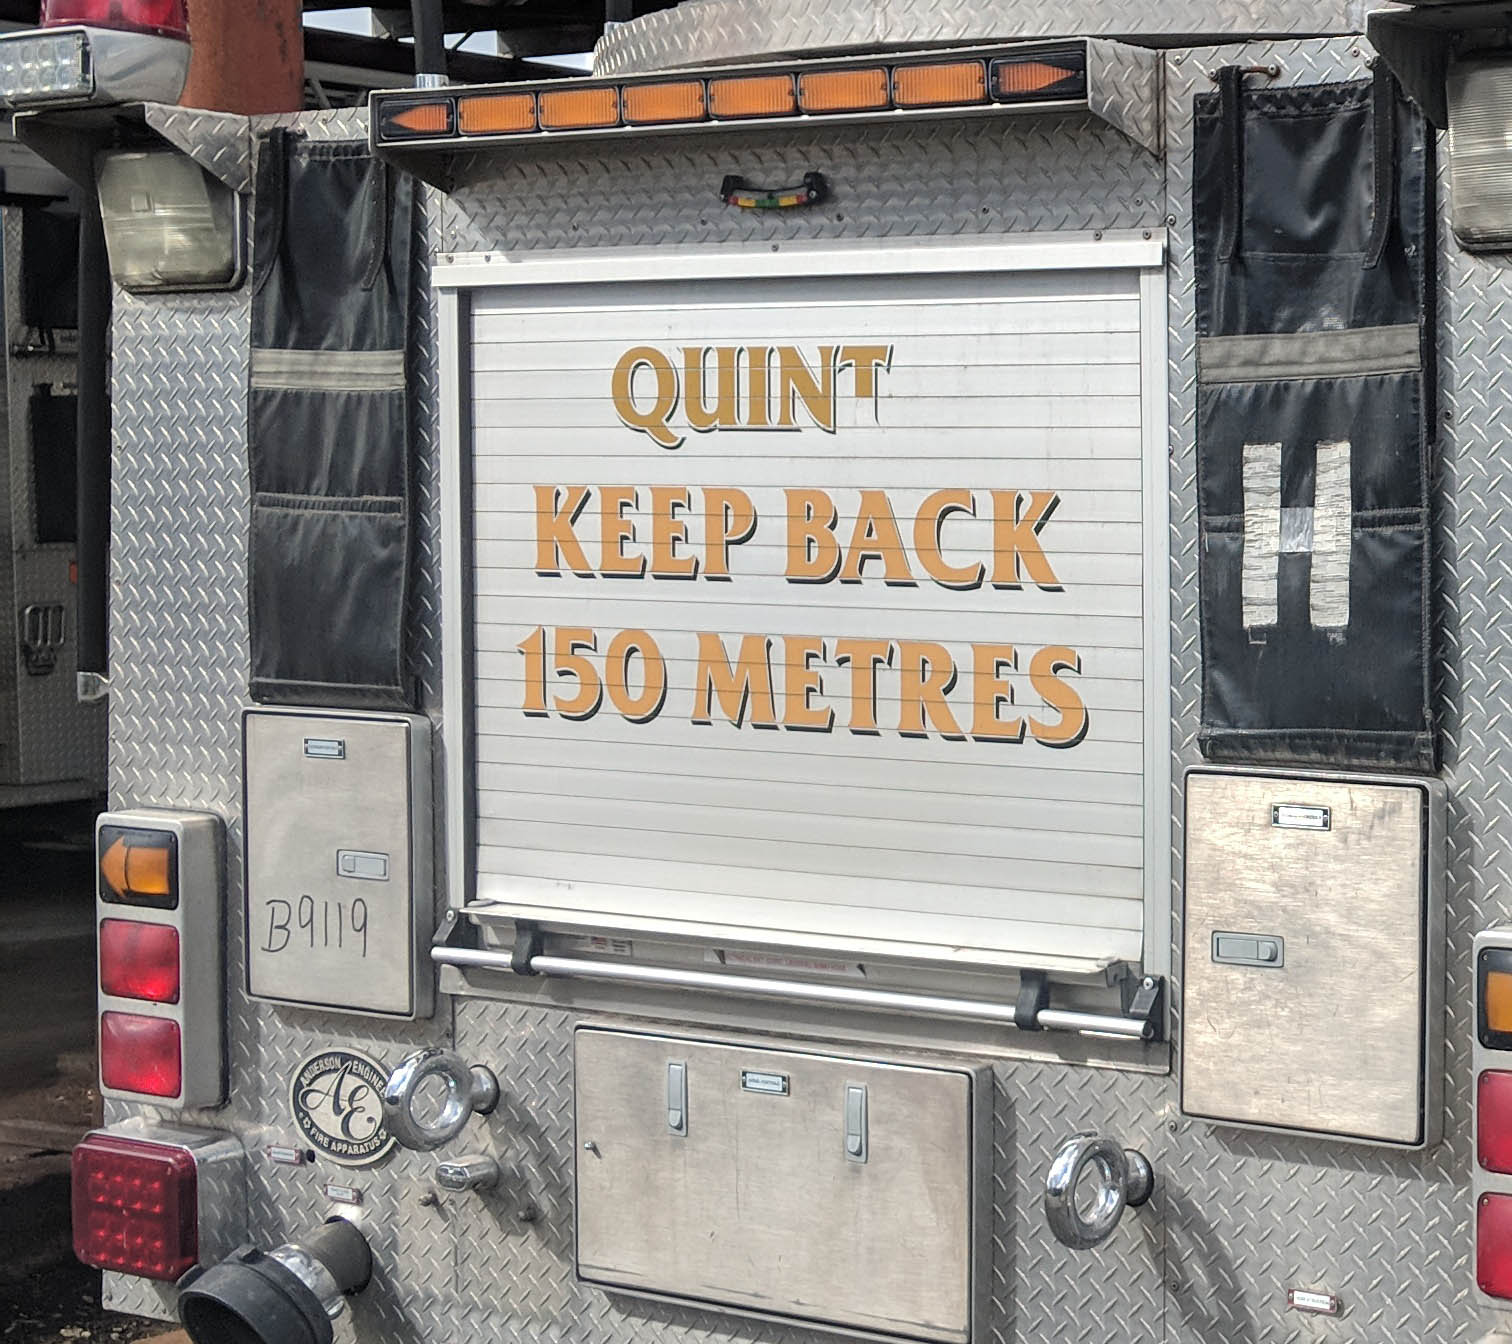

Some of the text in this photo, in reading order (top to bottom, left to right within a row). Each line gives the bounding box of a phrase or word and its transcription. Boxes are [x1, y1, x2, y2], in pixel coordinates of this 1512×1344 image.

[611, 344, 894, 449] QUINT
[533, 484, 1065, 592] KEEP BACK
[516, 625, 1090, 749] 150 METRES
[261, 895, 367, 958] B9119
[300, 1057, 341, 1087] ANDERSON
[309, 1128, 381, 1155] FIRE APPARATUS
